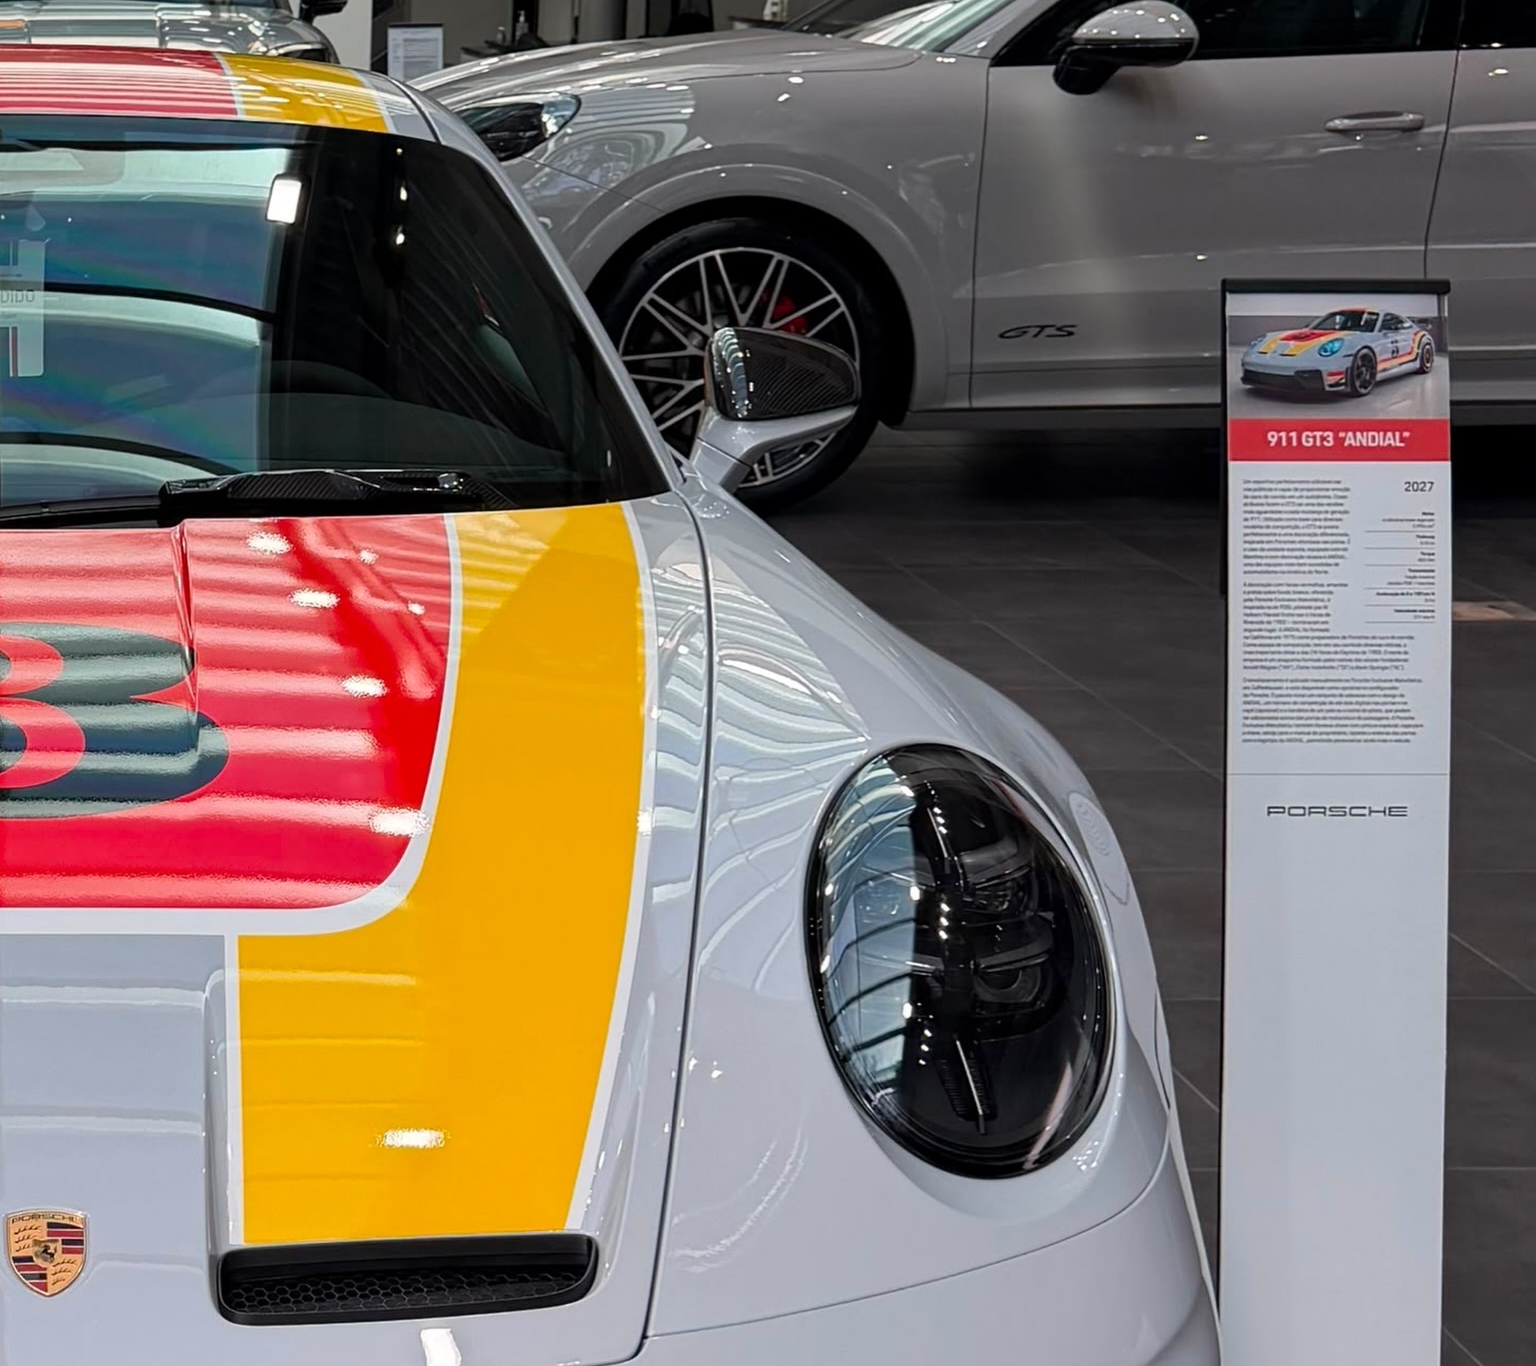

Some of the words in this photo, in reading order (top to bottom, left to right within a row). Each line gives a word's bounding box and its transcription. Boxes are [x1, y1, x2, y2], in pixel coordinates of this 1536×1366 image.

[997, 324, 1078, 339] GTS
[1267, 431, 1297, 447] 911
[1301, 431, 1334, 447] GT3
[1404, 481, 1435, 493] 2027
[1267, 806, 1409, 817] PORSCHE
